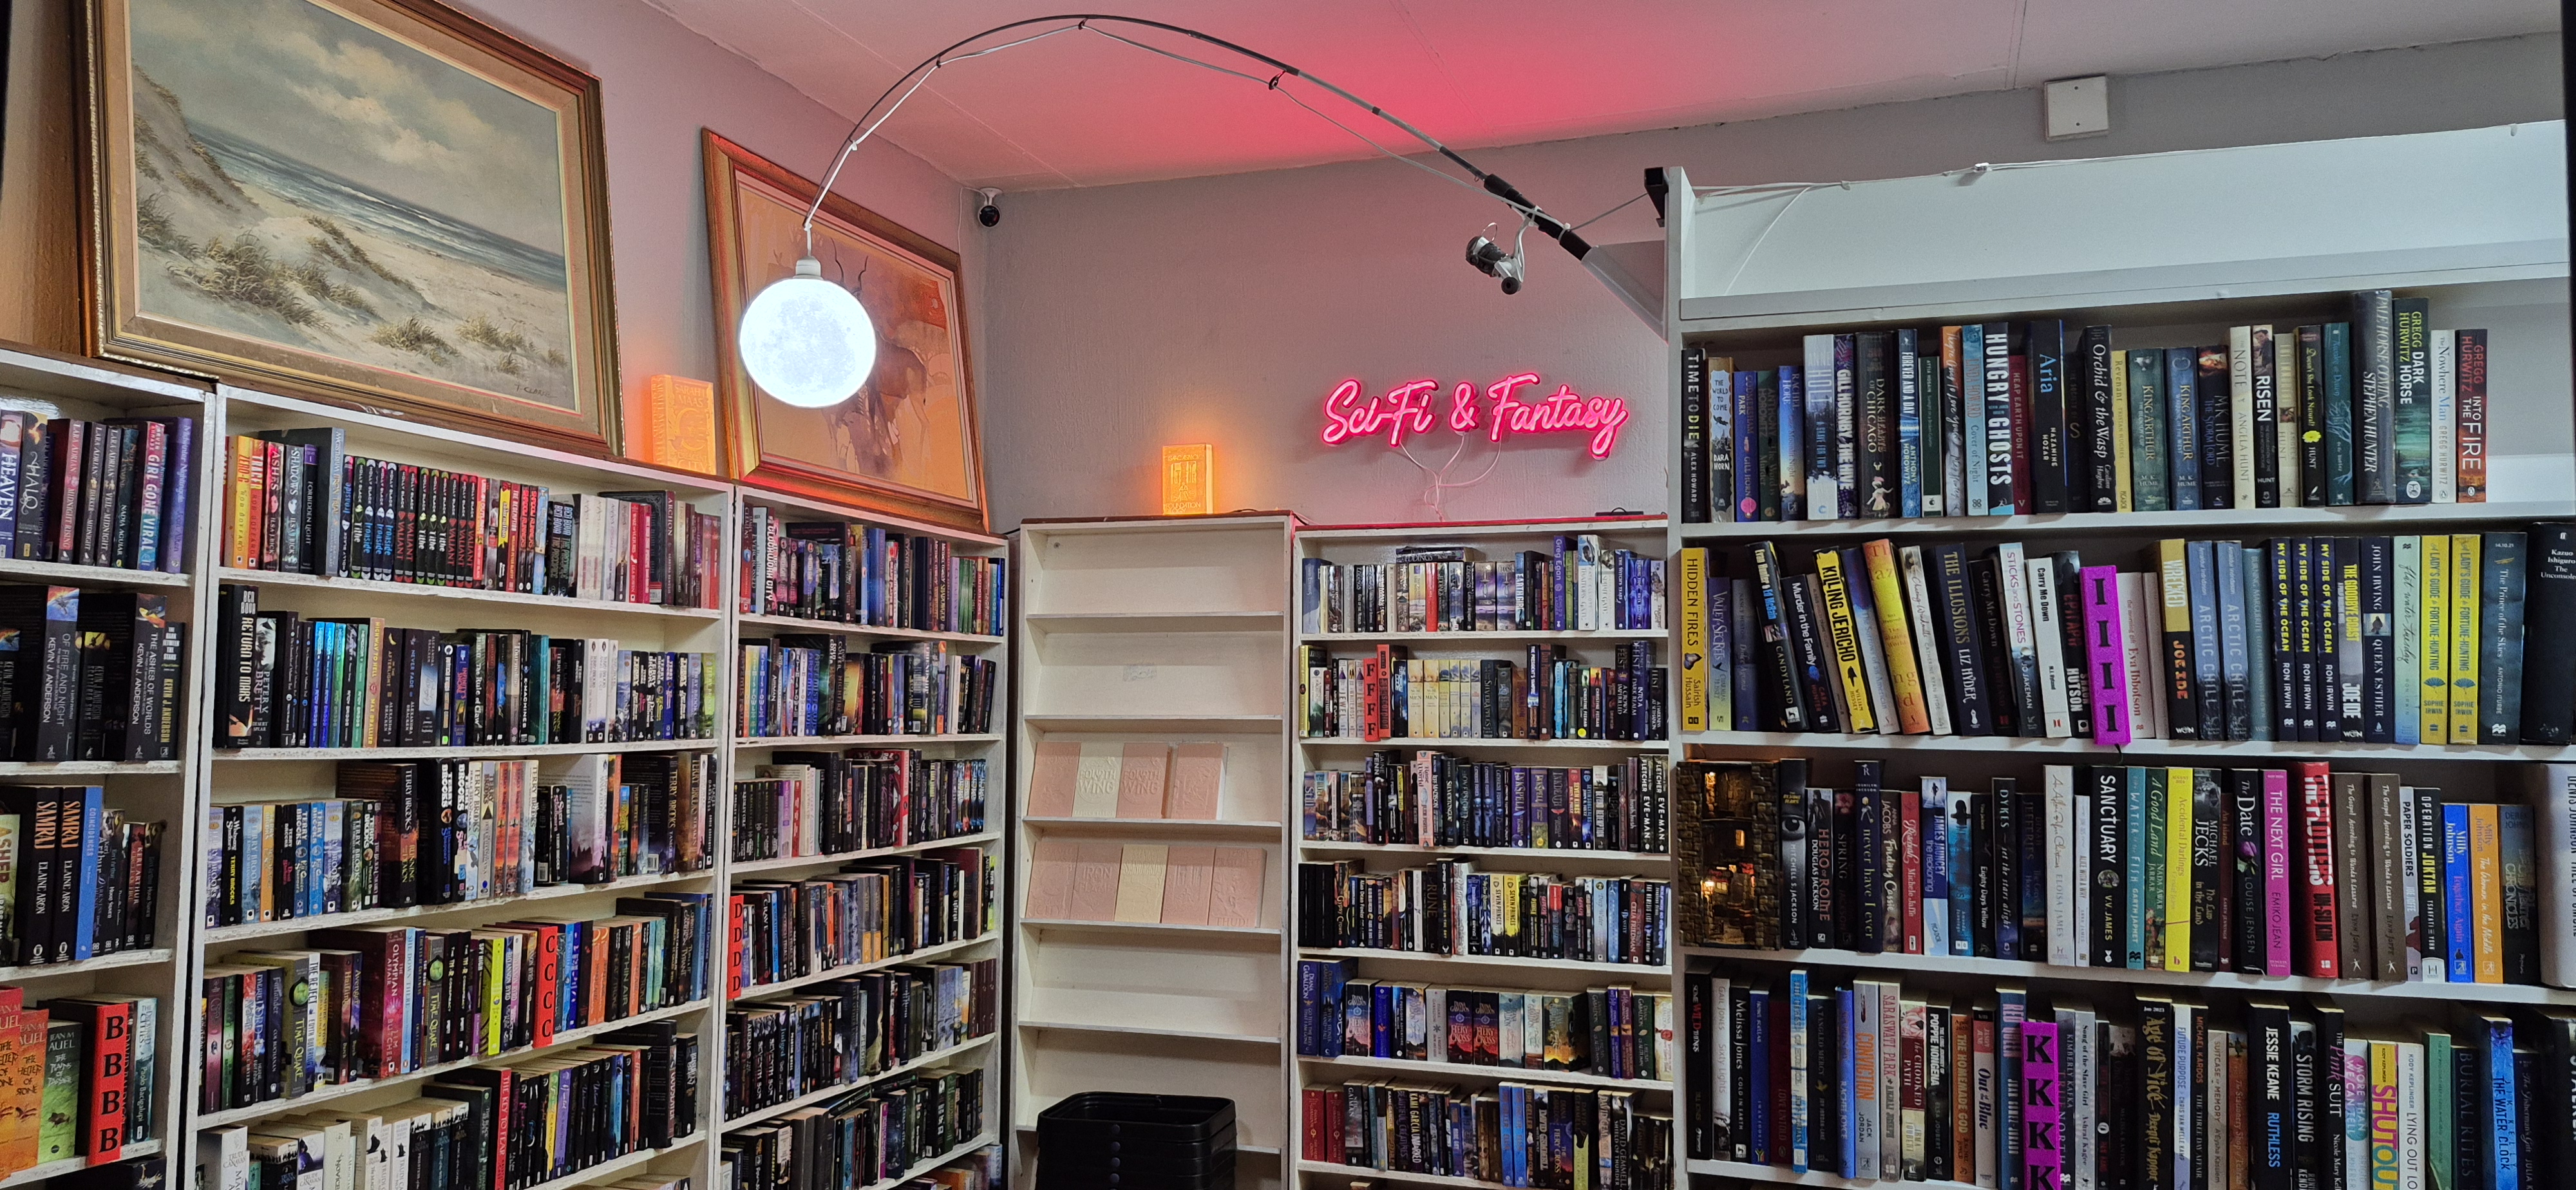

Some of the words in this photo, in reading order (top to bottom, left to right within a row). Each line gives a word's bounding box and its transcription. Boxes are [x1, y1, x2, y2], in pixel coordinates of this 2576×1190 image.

[2399, 312, 2409, 362] HURWITZ
[2412, 311, 2421, 348] GREGG
[1902, 352, 1915, 380] FOREVER
[1985, 334, 2009, 402] HUNGRY
[2040, 354, 2057, 393] Aria
[2093, 344, 2107, 386] Orchid
[2412, 352, 2425, 384] DARK
[1837, 370, 1851, 391] GILL
[1902, 381, 1915, 394] AND
[2400, 365, 2412, 404] HORSE
[679, 395, 703, 406] MAAS
[1903, 402, 1915, 414] DAY
[2094, 391, 2107, 404] &
[2257, 375, 2271, 420] RISEN
[2363, 372, 2376, 427] STEPHEN
[2463, 398, 2472, 418] THE
[2472, 396, 2481, 420] INTO
[1322, 380, 1439, 446] Sci-Fi
[1451, 382, 1479, 433] &
[1487, 373, 1629, 460] Fantasy
[1837, 393, 1853, 438] HORNBY
[2094, 407, 2107, 424] the
[1839, 443, 1853, 462] THE
[1988, 417, 2011, 485] GHOSTS
[2094, 426, 2108, 458] Wasp
[2363, 426, 2377, 472] HUNTER
[2462, 422, 2481, 470] FIRE
[146, 454, 160, 480] GIRL
[290, 450, 300, 495] SHADOWS
[1839, 464, 1854, 489] HIVE
[0, 453, 17, 520] HEAVEN
[144, 484, 158, 514] GONE
[64, 488, 75, 524] MIDNIGHT
[63, 525, 73, 547] RISING
[142, 518, 156, 551] VIRAL
[1943, 552, 1960, 576] THE
[2321, 544, 2329, 557] MY
[1687, 559, 1698, 607] HIDDEN
[2037, 568, 2047, 587] Carry
[2322, 560, 2330, 581] SIDE
[1792, 583, 1804, 613] Murder
[1822, 566, 1844, 610] KILLING
[2007, 552, 2018, 588] STICKS
[2013, 603, 2025, 643] STONES
[2040, 589, 2048, 600] Me
[2093, 579, 2107, 605] I
[2323, 584, 2331, 596] OF
[1947, 580, 1969, 644] ILLUSIONS
[2041, 601, 2050, 621] Down
[2322, 600, 2331, 618] THE
[240, 618, 254, 656] RETURN
[1688, 612, 1698, 646] FIRES
[1800, 623, 1810, 638] the
[1832, 612, 1856, 662] JERICHO
[2097, 620, 2111, 647] I
[2324, 621, 2333, 654] OCEAN
[2459, 607, 2470, 671] FORTUNE-HUNTING
[136, 643, 144, 667] KEVIN
[148, 652, 157, 680] ASHES
[1803, 638, 1817, 666] Family
[1958, 649, 1971, 665] LIZ
[2174, 640, 2185, 668] JOE
[240, 661, 252, 673] TO
[1367, 664, 1375, 676] F
[1776, 646, 1793, 704] CANDYLAND
[2100, 663, 2114, 689] I
[147, 683, 155, 694] OF
[238, 676, 251, 703] MARS
[1367, 684, 1375, 696] F
[1961, 668, 1976, 703] HYDER
[2066, 668, 2083, 712] HUTSON
[2175, 671, 2188, 699] IDE
[132, 678, 142, 724] ANDERSON
[1367, 703, 1376, 715] F
[144, 697, 154, 735] WORLDS
[1367, 723, 1376, 735] F
[2105, 705, 2119, 732] I
[1079, 780, 1115, 794] WING
[1080, 768, 1115, 779] FOURTH
[2152, 777, 2161, 787] A
[2000, 789, 2009, 828] DYKES
[2150, 790, 2163, 820] Good
[2237, 795, 2256, 836] Date
[2270, 790, 2282, 815] THE
[2403, 801, 2412, 829] PAPER
[34, 802, 57, 849] SAMRAJ
[61, 801, 80, 848] SAMRAJ
[2100, 775, 2120, 863] SANCTUARY
[2271, 817, 2283, 849] NEXT
[1862, 829, 1872, 864] never
[2150, 823, 2163, 856] Land
[1811, 840, 1819, 876] DOUGLAS
[2271, 852, 2284, 880] GIRL
[2404, 833, 2413, 877] SOLDIERS
[1811, 877, 1820, 911] JACKSON
[1864, 869, 1875, 897] have
[35, 892, 46, 914] ARON
[735, 903, 742, 918] D
[734, 927, 742, 943] D
[1866, 912, 1874, 939] ever
[546, 935, 554, 952] C
[545, 963, 554, 981] C
[734, 952, 741, 967] D
[308, 977, 318, 1004] REJECT
[733, 976, 740, 991] D
[544, 991, 553, 1009] C
[106, 1015, 124, 1040] B
[295, 1018, 305, 1043] TIME
[542, 1019, 551, 1037] C
[1736, 999, 1745, 1039] Melissa
[1450, 1034, 1470, 1043] CROSS
[2026, 1034, 2053, 1064] K
[2266, 1026, 2278, 1061] JESSIE
[103, 1053, 122, 1077] B
[294, 1046, 304, 1081] QUAKE
[1734, 1041, 1745, 1070] Jones
[1856, 1032, 1875, 1100] CONVICTION
[2327, 1045, 2344, 1081] Pink
[2267, 1064, 2279, 1100] KEANE
[2296, 1054, 2313, 1095] STORM
[2492, 1075, 2505, 1095] THE
[102, 1090, 120, 1115] B
[2027, 1079, 2054, 1107] K
[2329, 1083, 2342, 1117] SUIT
[2298, 1099, 2314, 1142] RISING
[2494, 1098, 2507, 1131] WATER
[99, 1128, 118, 1153] B
[2027, 1122, 2056, 1150] K
[2268, 1112, 2280, 1167] RUTHLESS
[2498, 1137, 2510, 1170] CLOCK
[2027, 1165, 2056, 1190] K
